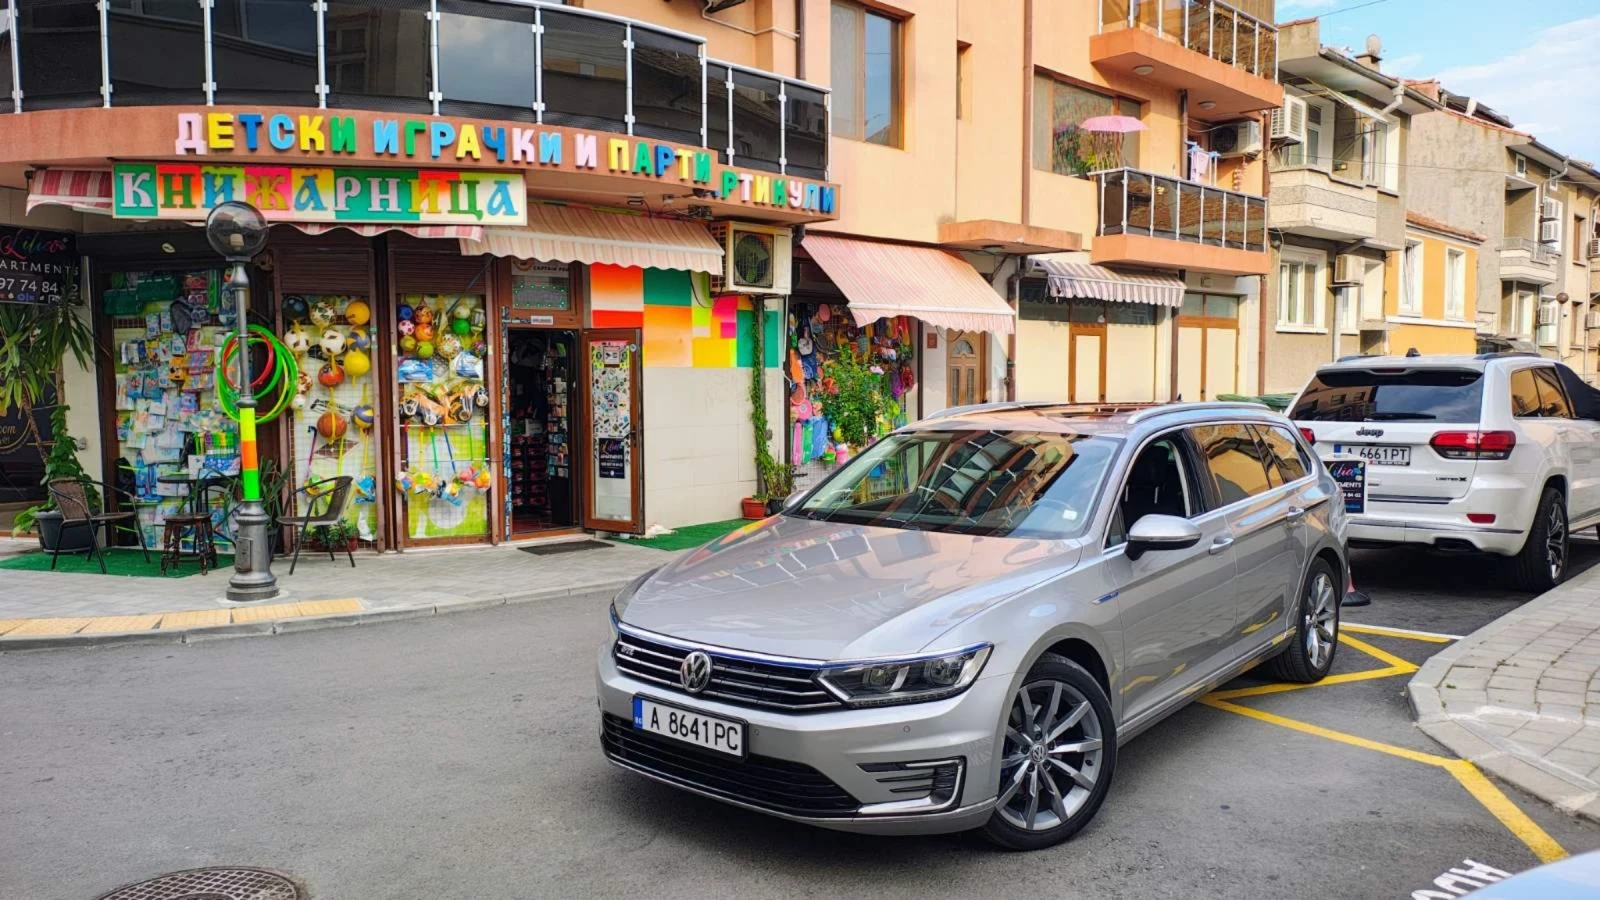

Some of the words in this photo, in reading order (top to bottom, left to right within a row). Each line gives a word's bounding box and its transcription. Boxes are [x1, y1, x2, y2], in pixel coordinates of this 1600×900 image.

[175, 112, 357, 155] ДЕТСКИ
[373, 119, 562, 164] ИГРАЧКИ
[574, 133, 597, 168] И
[607, 138, 711, 184] ПАРТИ
[713, 170, 835, 213] РТИКУЛИ
[119, 171, 519, 221] КНИЖАРНИЦА
[19, 279, 38, 292] 74
[41, 281, 59, 293] 84
[1356, 427, 1384, 438] Jeep
[650, 706, 660, 731] A
